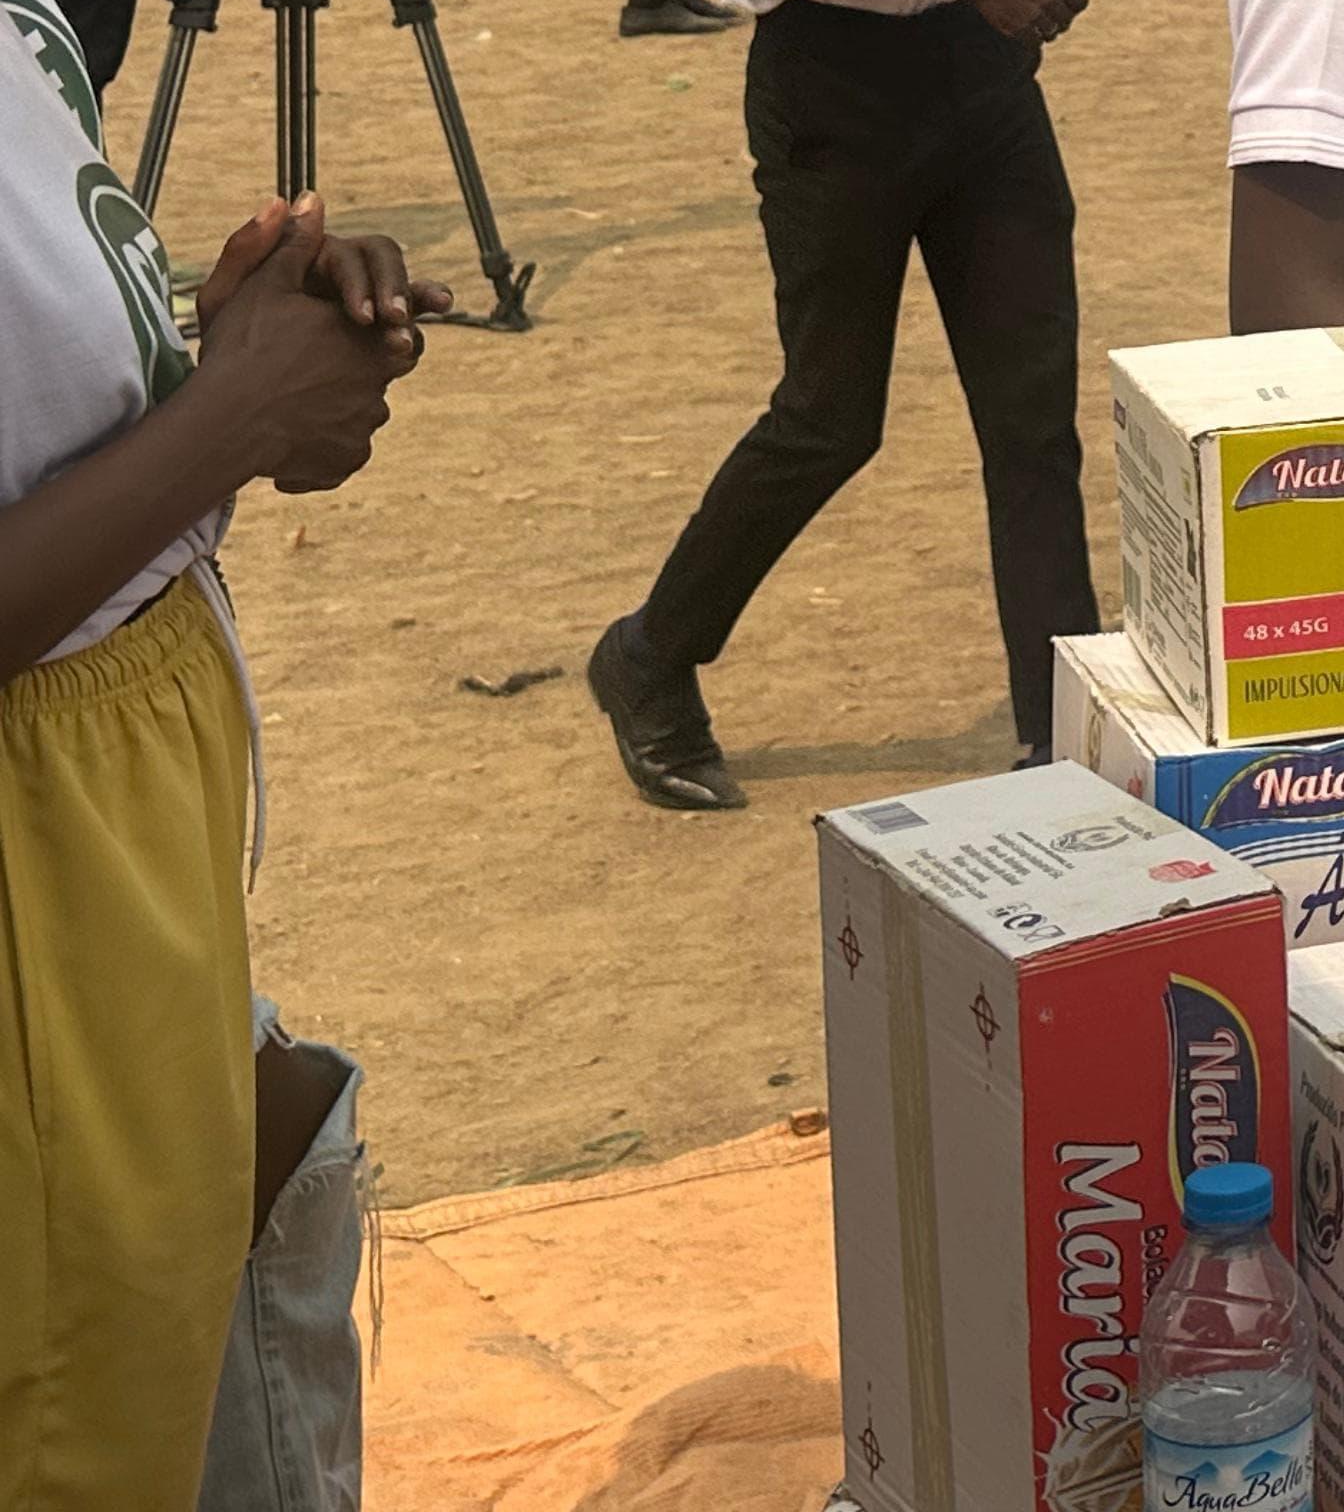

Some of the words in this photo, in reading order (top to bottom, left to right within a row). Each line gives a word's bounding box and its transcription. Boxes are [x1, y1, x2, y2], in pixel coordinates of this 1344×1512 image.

[1243, 624, 1270, 641] 48
[1273, 625, 1286, 639] x
[1289, 616, 1330, 636] 45G
[1053, 1141, 1146, 1434] Maria
